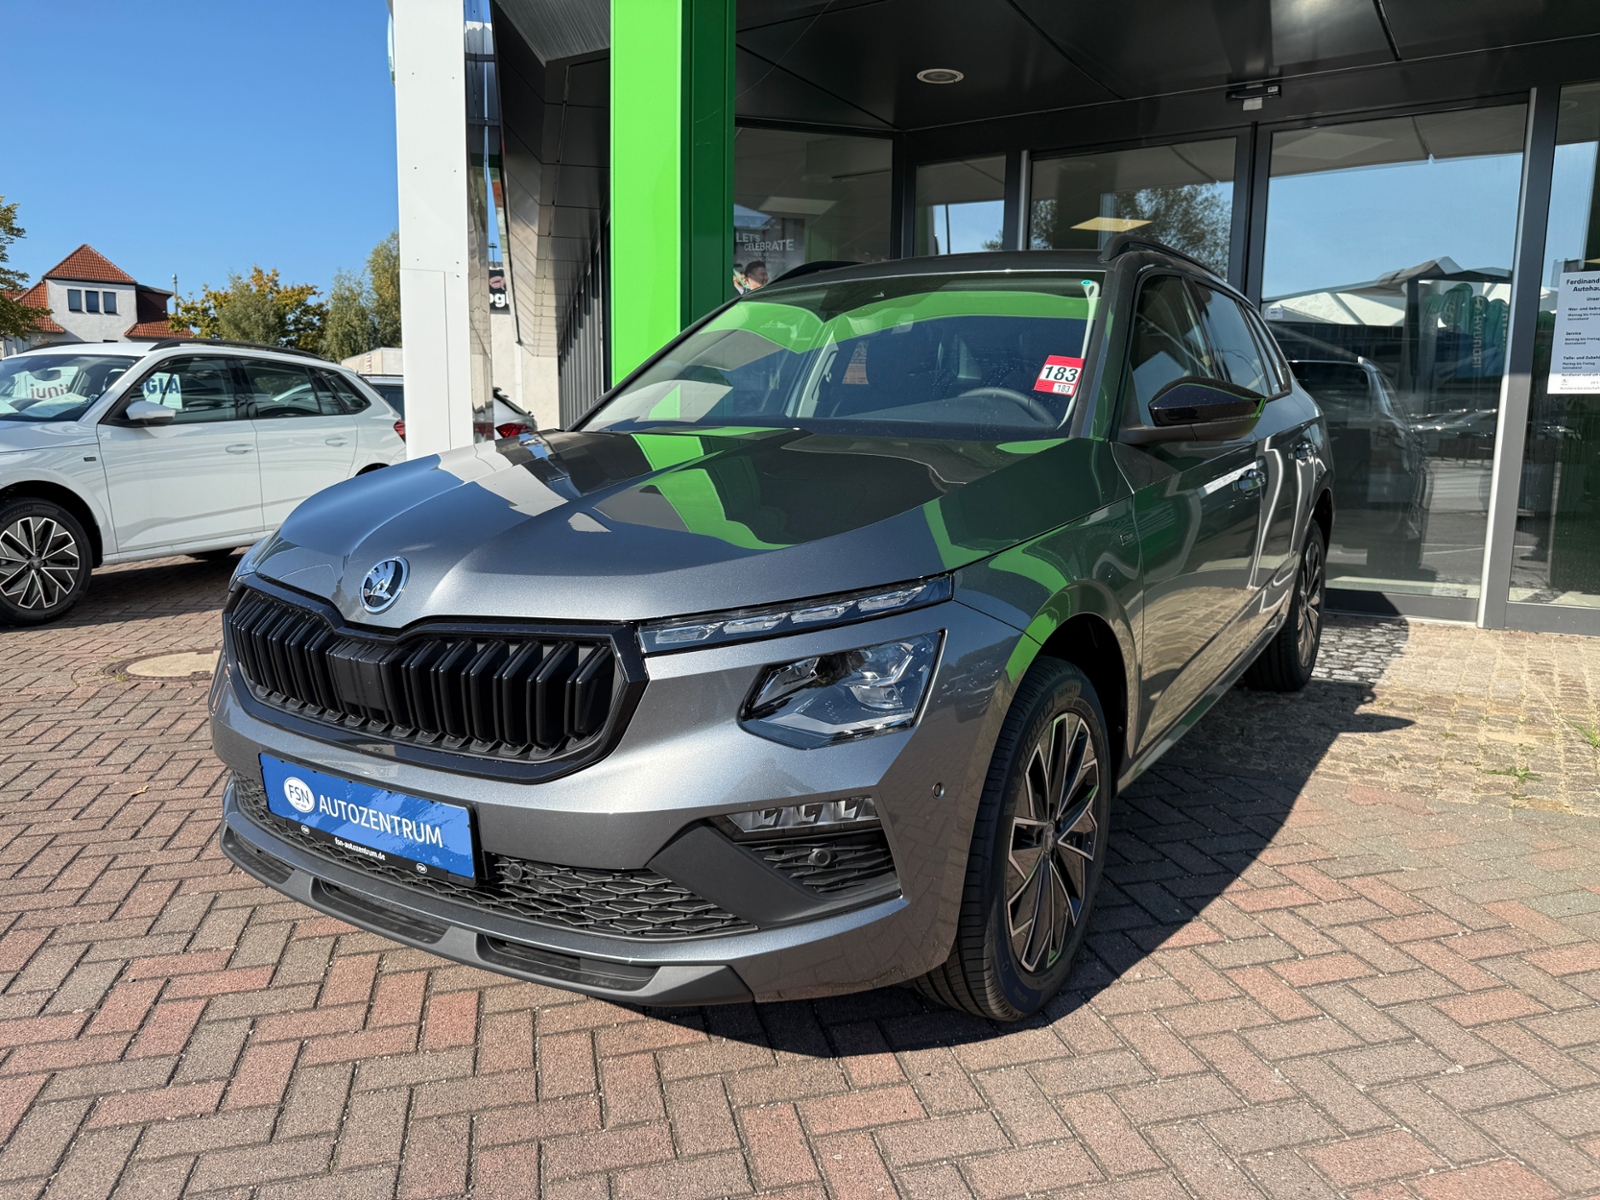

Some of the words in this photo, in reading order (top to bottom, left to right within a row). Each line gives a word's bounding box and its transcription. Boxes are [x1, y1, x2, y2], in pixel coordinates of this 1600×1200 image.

[736, 232, 760, 242] LET'S
[744, 239, 794, 252] CELEBRATE
[1472, 316, 1482, 368] HYUNDAI
[1045, 366, 1078, 382] 183
[288, 784, 310, 805] FSN
[319, 794, 443, 849] AUTOZENTRUM
[334, 837, 386, 861] fsn-autozentrum.de
